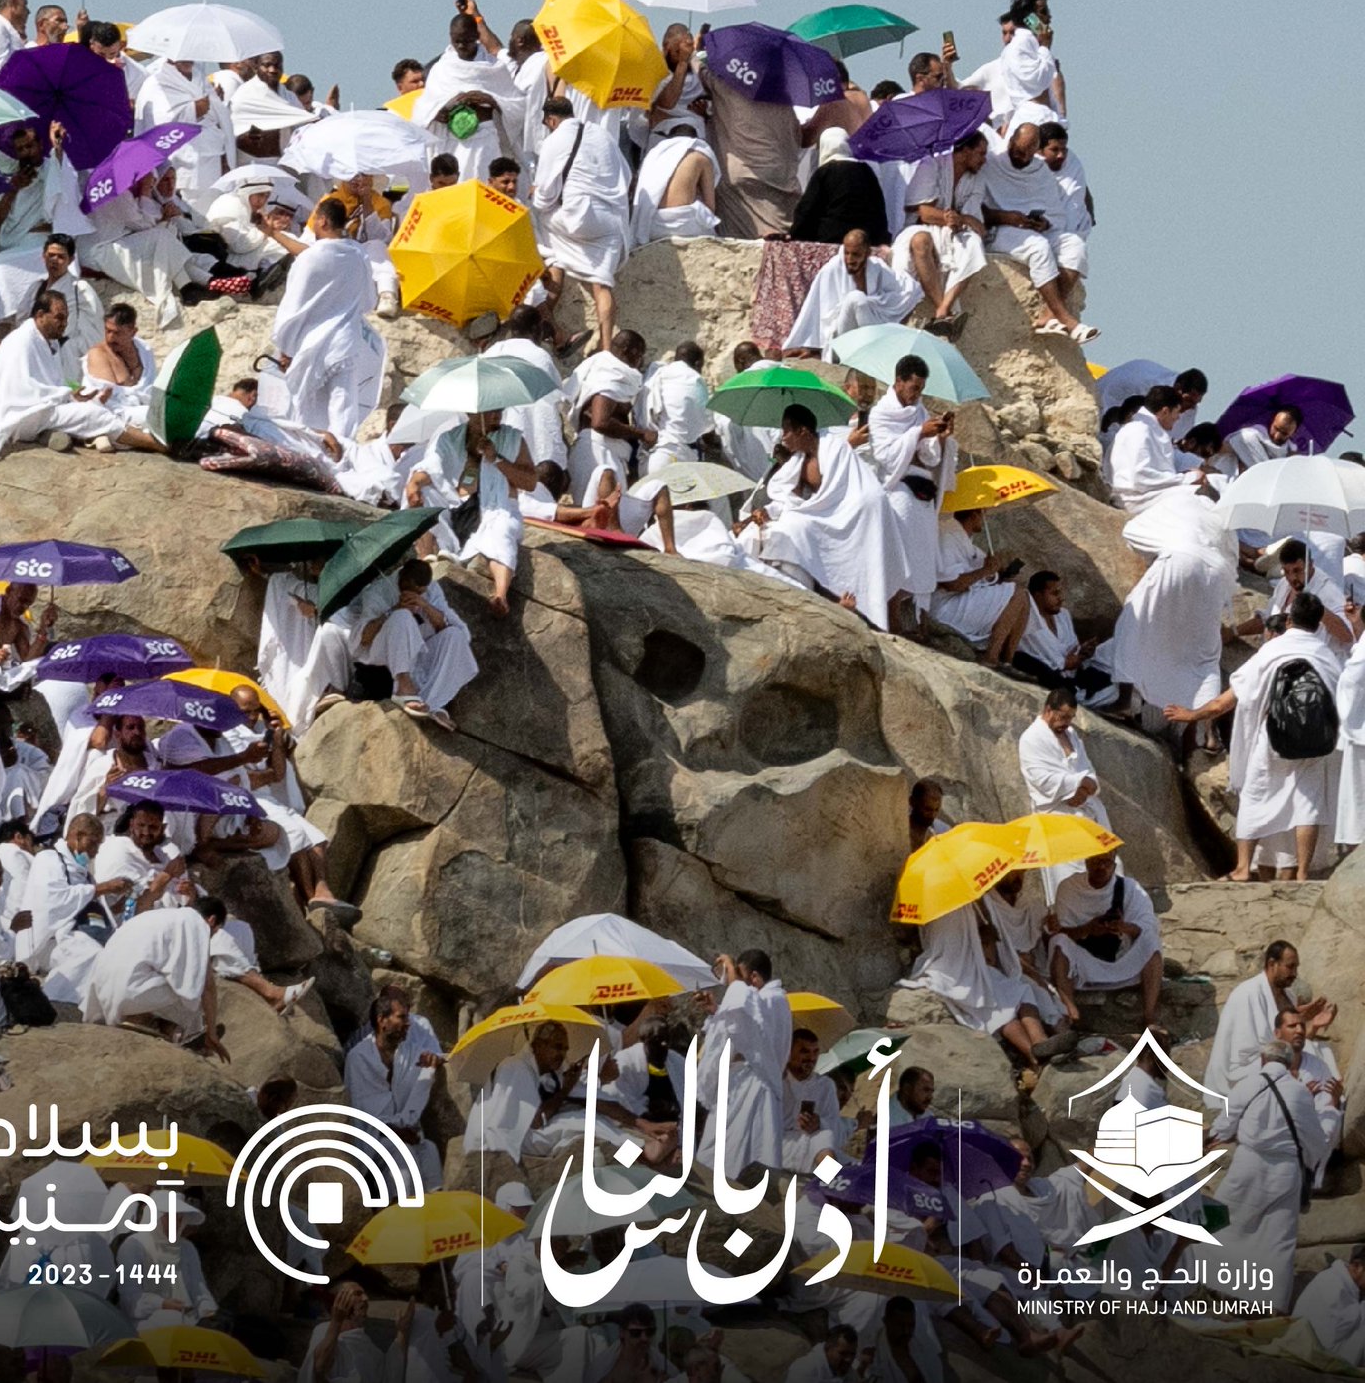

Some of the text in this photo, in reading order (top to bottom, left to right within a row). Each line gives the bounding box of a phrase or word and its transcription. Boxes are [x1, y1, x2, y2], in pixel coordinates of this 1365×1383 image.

[543, 22, 567, 64] DHL
[724, 56, 759, 87] stc
[610, 85, 647, 104] DHL
[812, 77, 837, 98] stc
[154, 127, 186, 151] stc
[88, 176, 115, 204] stc
[994, 479, 1037, 500] DHL
[14, 557, 54, 578] stc
[49, 643, 83, 661] stc
[144, 639, 179, 656] stc
[184, 700, 218, 723] stc
[122, 775, 158, 790] stc
[220, 791, 254, 810] stc
[973, 857, 1011, 890] DHL
[596, 982, 638, 999] DHL
[912, 1192, 945, 1213] stc
[431, 1232, 480, 1254] DHL
[875, 1262, 917, 1280] DHL
[178, 1350, 222, 1365] DHL
